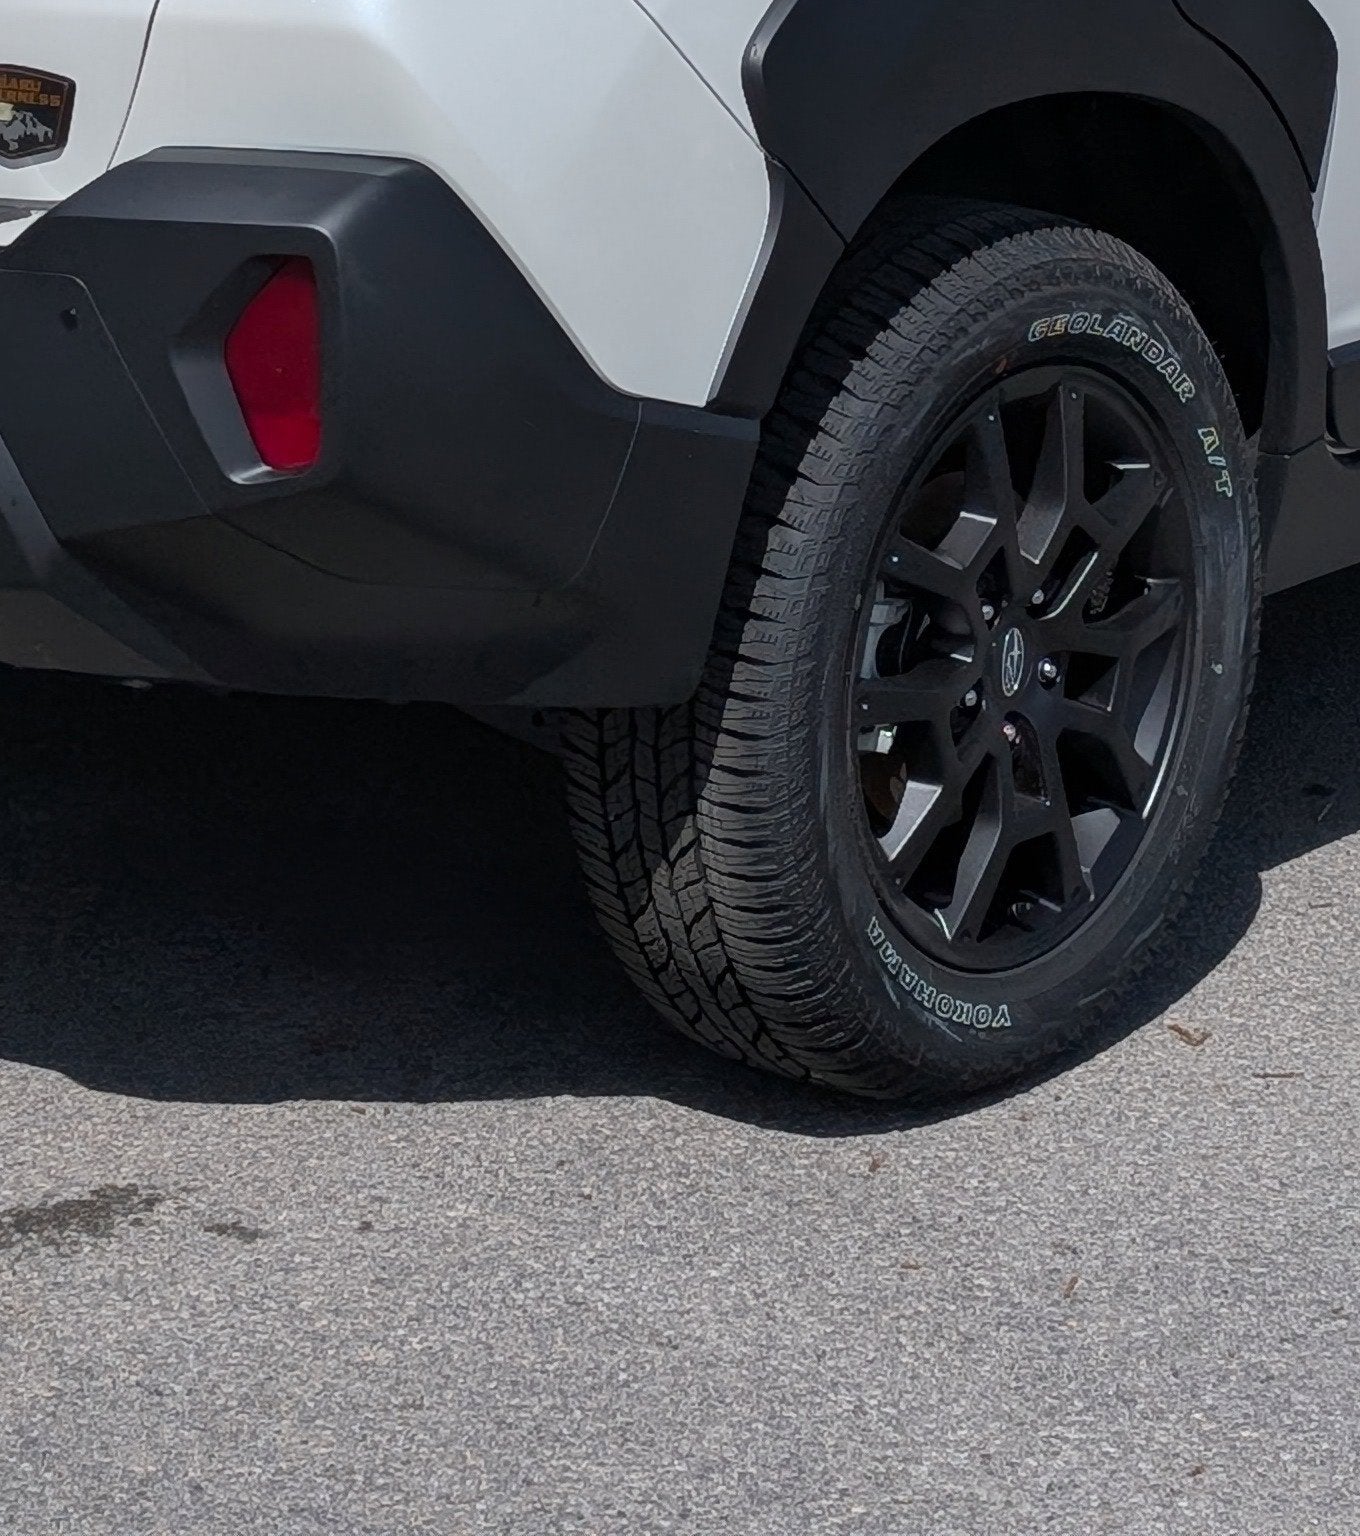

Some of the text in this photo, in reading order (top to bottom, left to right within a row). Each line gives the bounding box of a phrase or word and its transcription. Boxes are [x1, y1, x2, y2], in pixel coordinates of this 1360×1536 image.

[1028, 312, 1233, 498] GEOLANDAR A/T
[867, 915, 1012, 1029] YOKOHAMA
